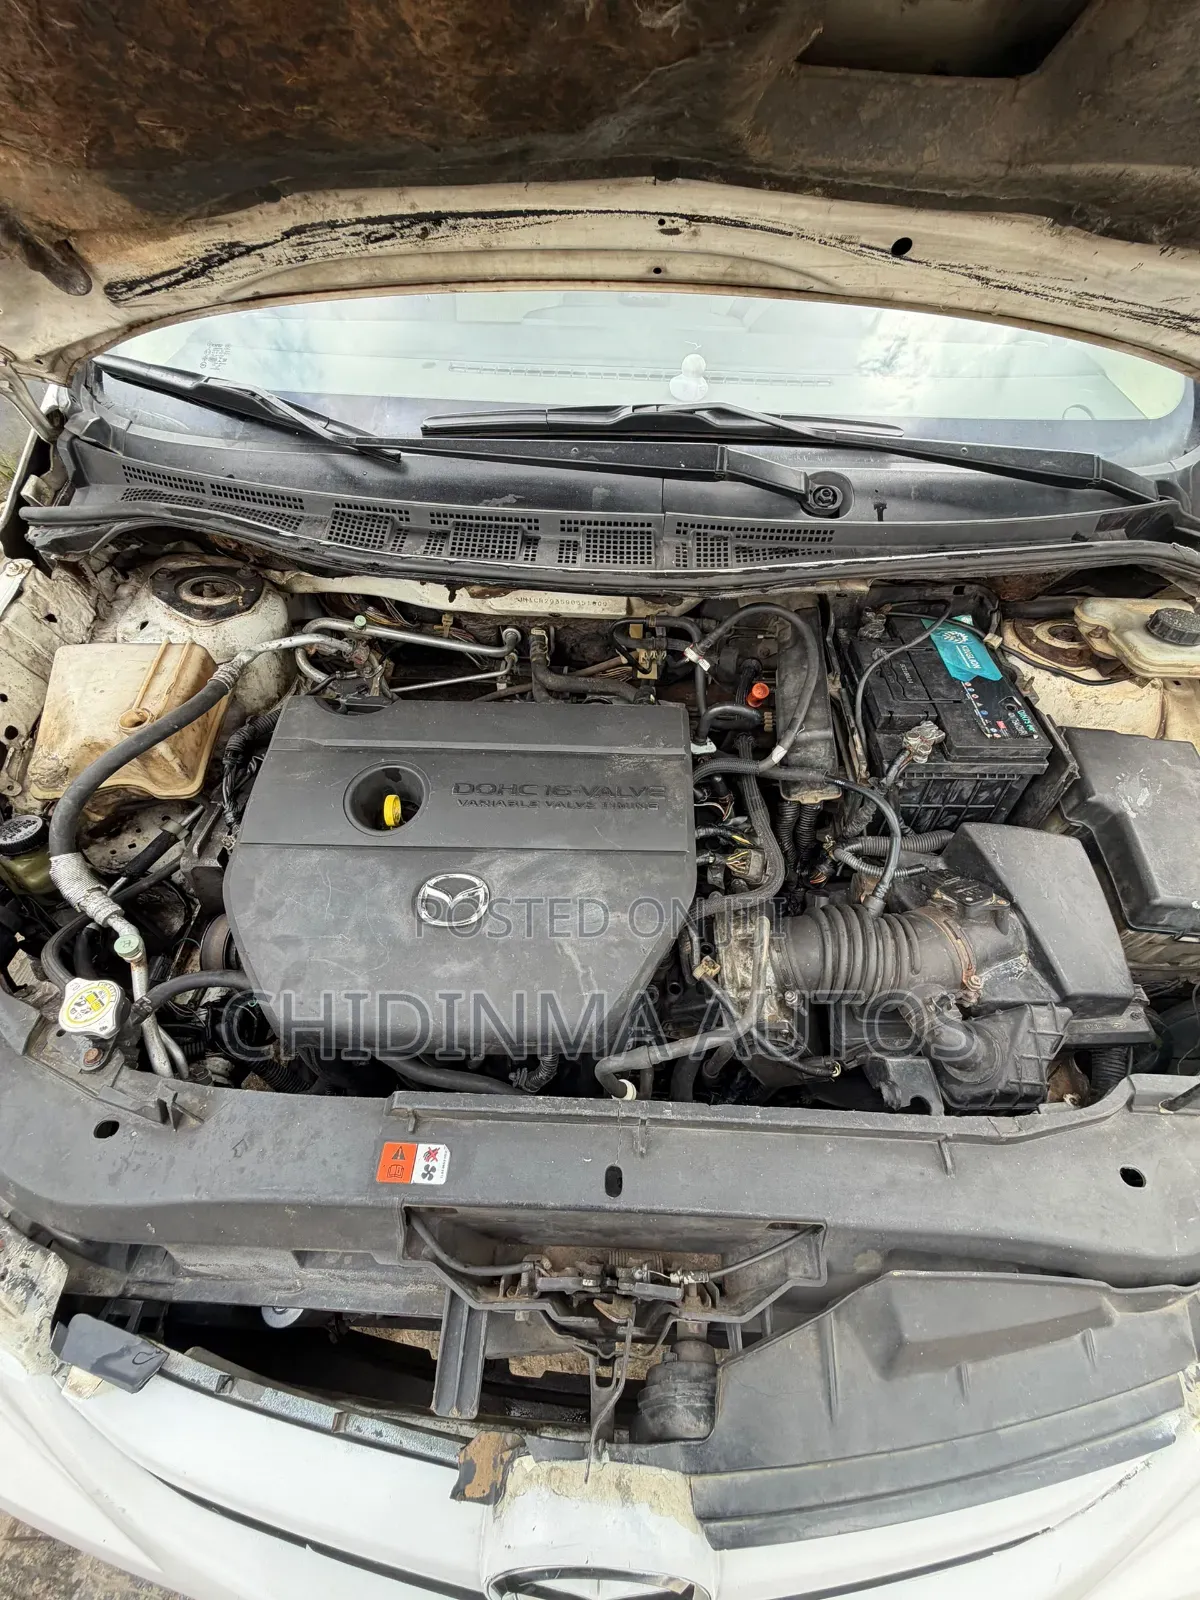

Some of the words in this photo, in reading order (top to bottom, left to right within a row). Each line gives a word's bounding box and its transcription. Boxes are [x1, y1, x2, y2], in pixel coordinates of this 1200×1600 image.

[961, 644, 981, 669] KINGLION
[452, 783, 538, 796] DOHC
[545, 785, 667, 799] 16-VALVE
[457, 799, 538, 808] VARIABLE
[545, 801, 596, 810] VALVE
[602, 802, 659, 811] TIMING
